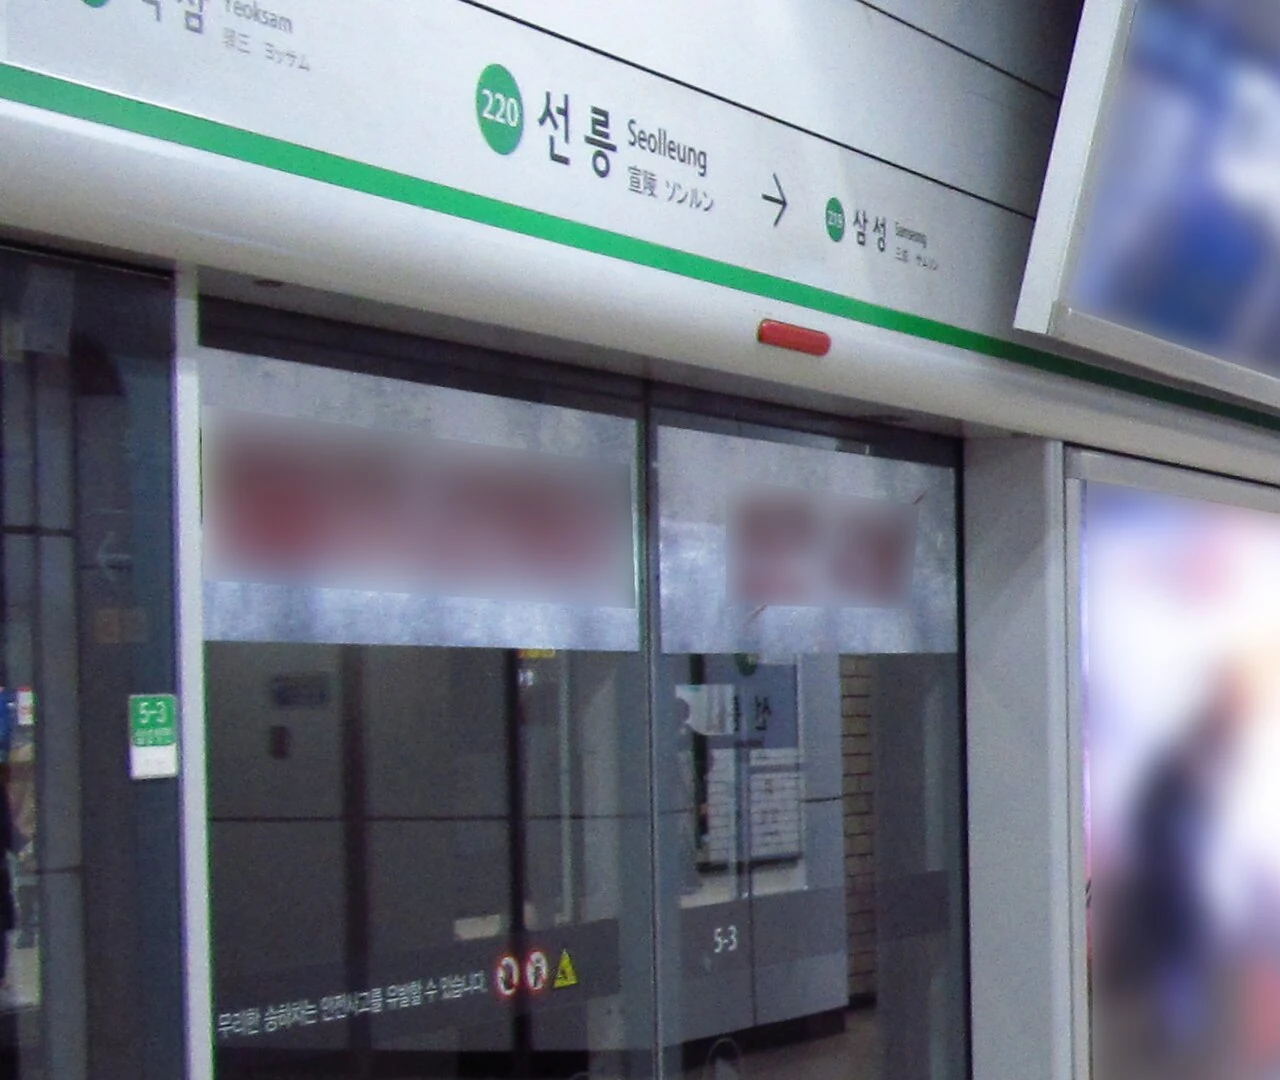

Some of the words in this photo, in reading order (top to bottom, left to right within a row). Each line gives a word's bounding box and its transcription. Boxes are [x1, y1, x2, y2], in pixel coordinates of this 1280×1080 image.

[481, 89, 520, 128] 220
[538, 90, 618, 178] 선릉
[627, 118, 708, 177] Seolleung
[853, 209, 887, 253] 삼성
[139, 701, 167, 724] 5-3
[713, 925, 738, 953] 5-3
[217, 1007, 261, 1039] 무리한
[424, 977, 438, 999] 수
